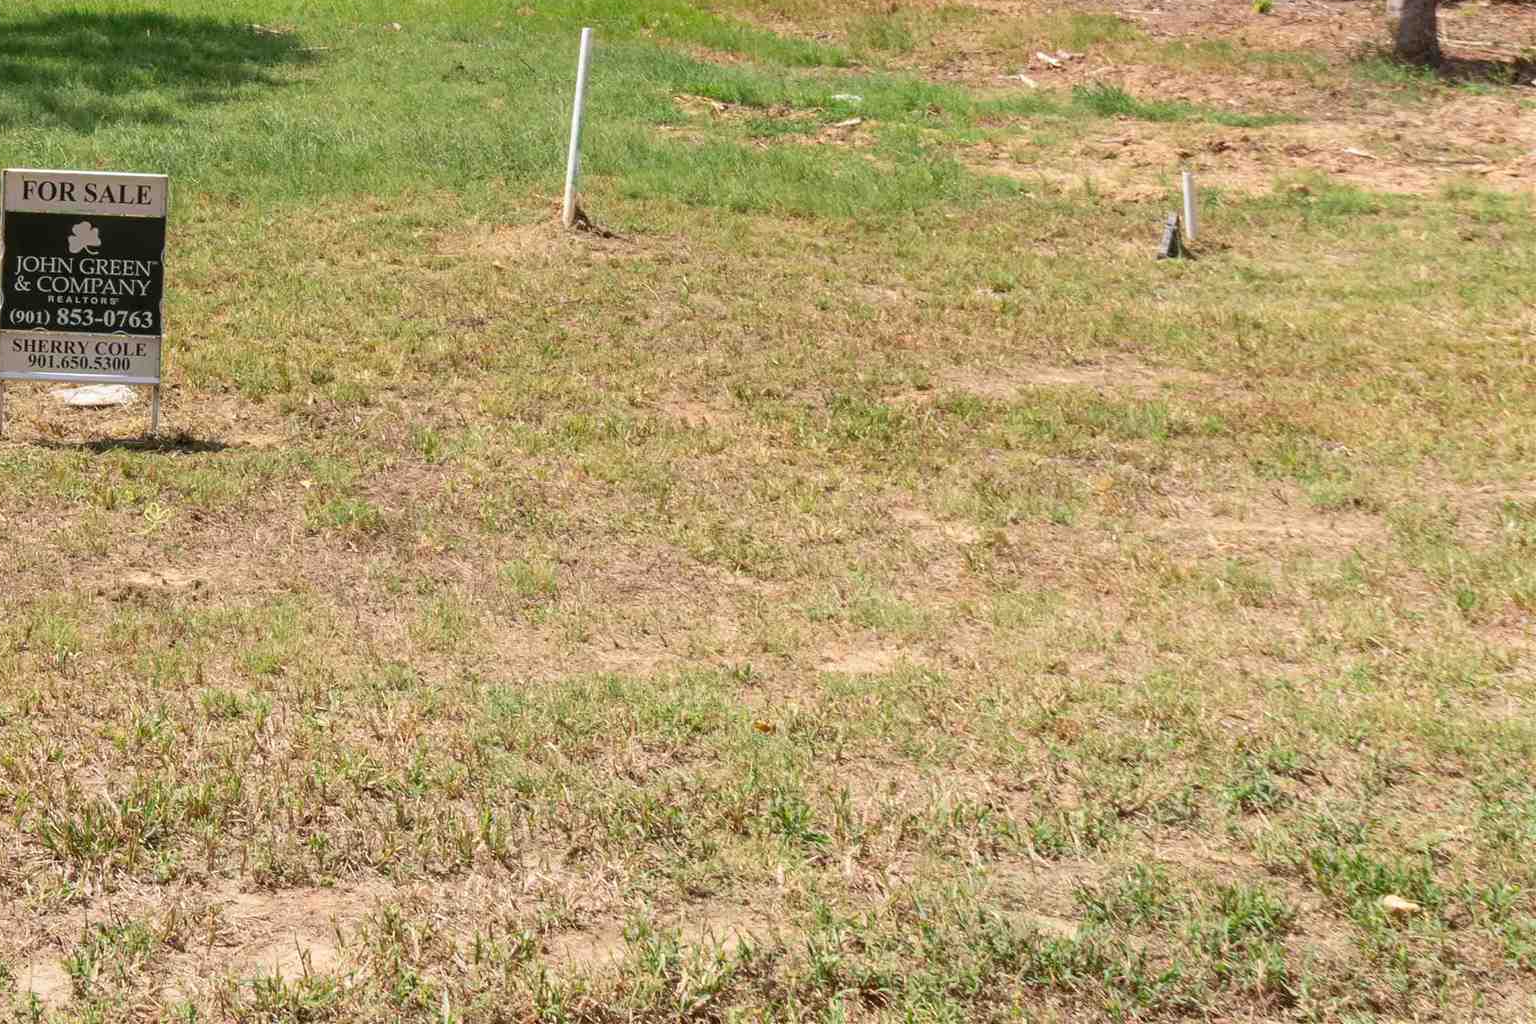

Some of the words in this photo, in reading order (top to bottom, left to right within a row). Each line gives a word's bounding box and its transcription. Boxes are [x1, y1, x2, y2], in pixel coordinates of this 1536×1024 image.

[22, 180, 76, 202] FOR
[84, 183, 152, 205] SALE
[14, 255, 73, 276] JOHN
[79, 258, 152, 276] GREEN
[14, 275, 31, 292] &
[37, 276, 152, 296] COMPANY
[9, 308, 50, 325] (901)
[57, 308, 153, 328] 853-0763
[13, 339, 89, 355] SHERRY
[95, 341, 146, 357] COLE
[28, 354, 130, 371] 901.650.5300
